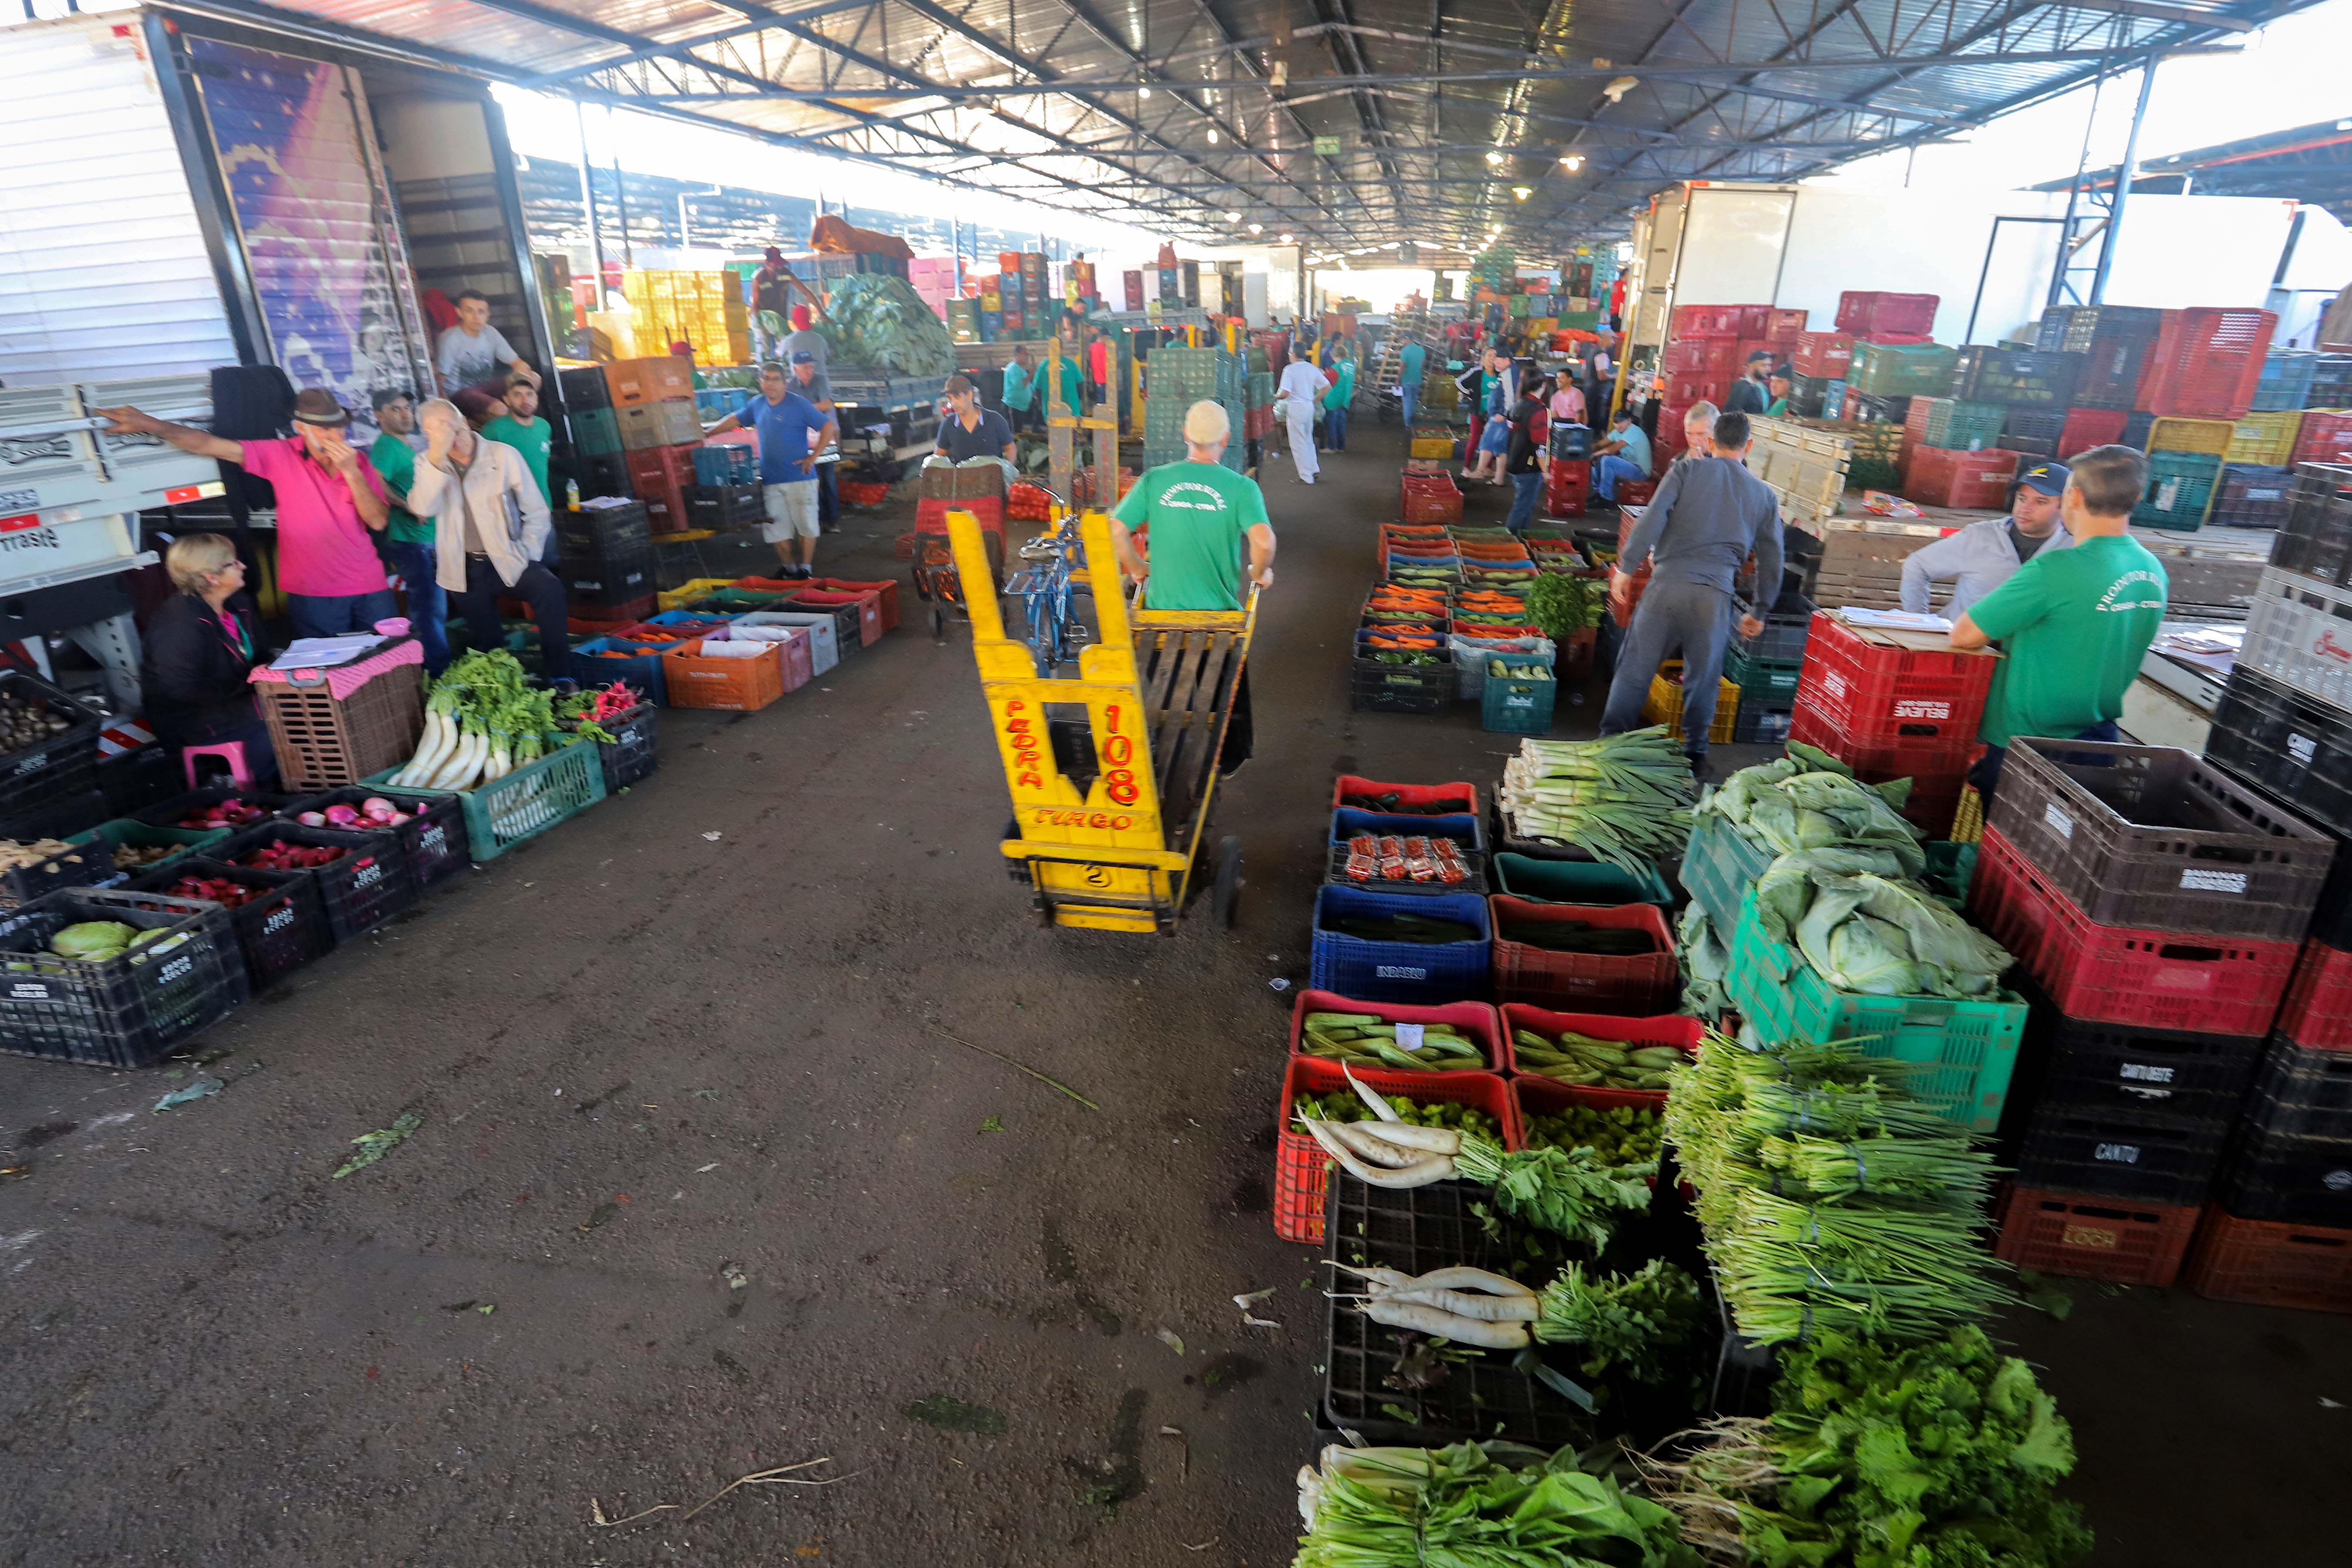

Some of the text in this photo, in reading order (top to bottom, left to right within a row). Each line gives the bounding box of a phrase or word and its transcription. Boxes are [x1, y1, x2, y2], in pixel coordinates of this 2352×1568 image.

[1894, 706, 1949, 719] BELIEVE
[1105, 705, 1139, 806] 108
[1035, 809, 1131, 830] TIAGO
[1086, 865, 1103, 883] 2
